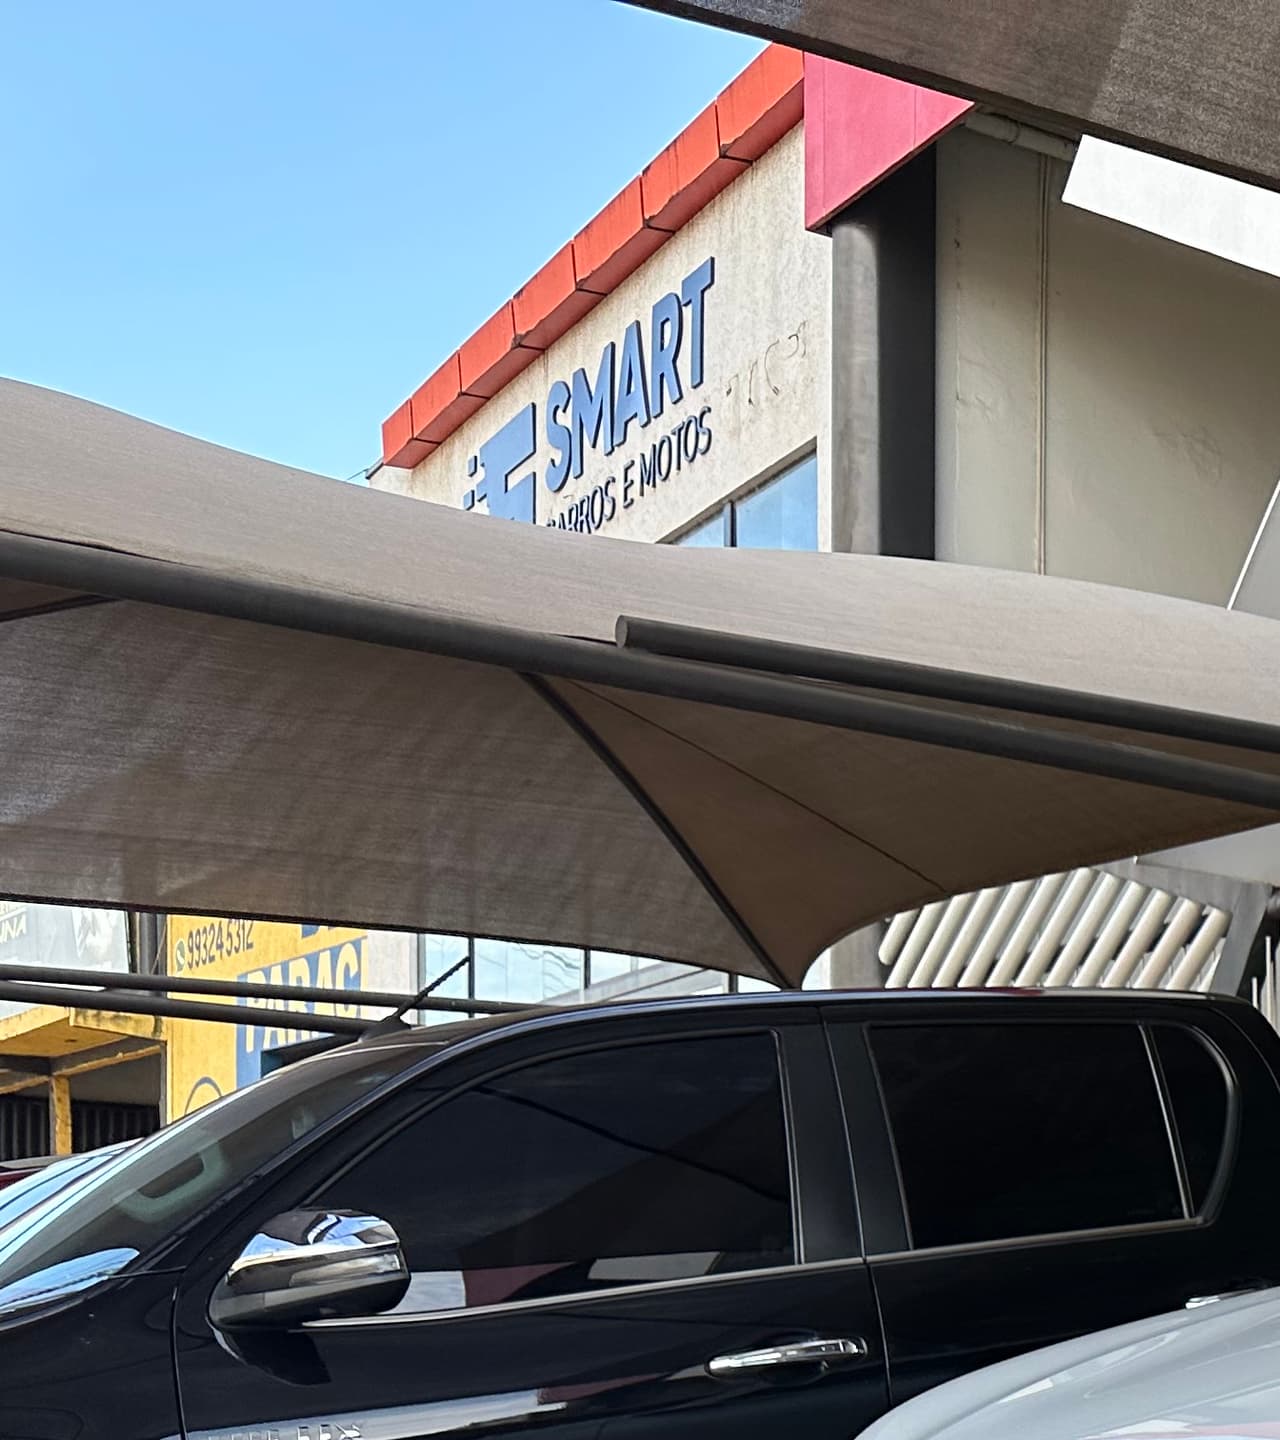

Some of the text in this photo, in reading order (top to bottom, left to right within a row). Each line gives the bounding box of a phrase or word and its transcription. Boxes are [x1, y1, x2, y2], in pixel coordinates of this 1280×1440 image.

[545, 256, 715, 493] SMART
[547, 406, 712, 534] RROS E MOTOS
